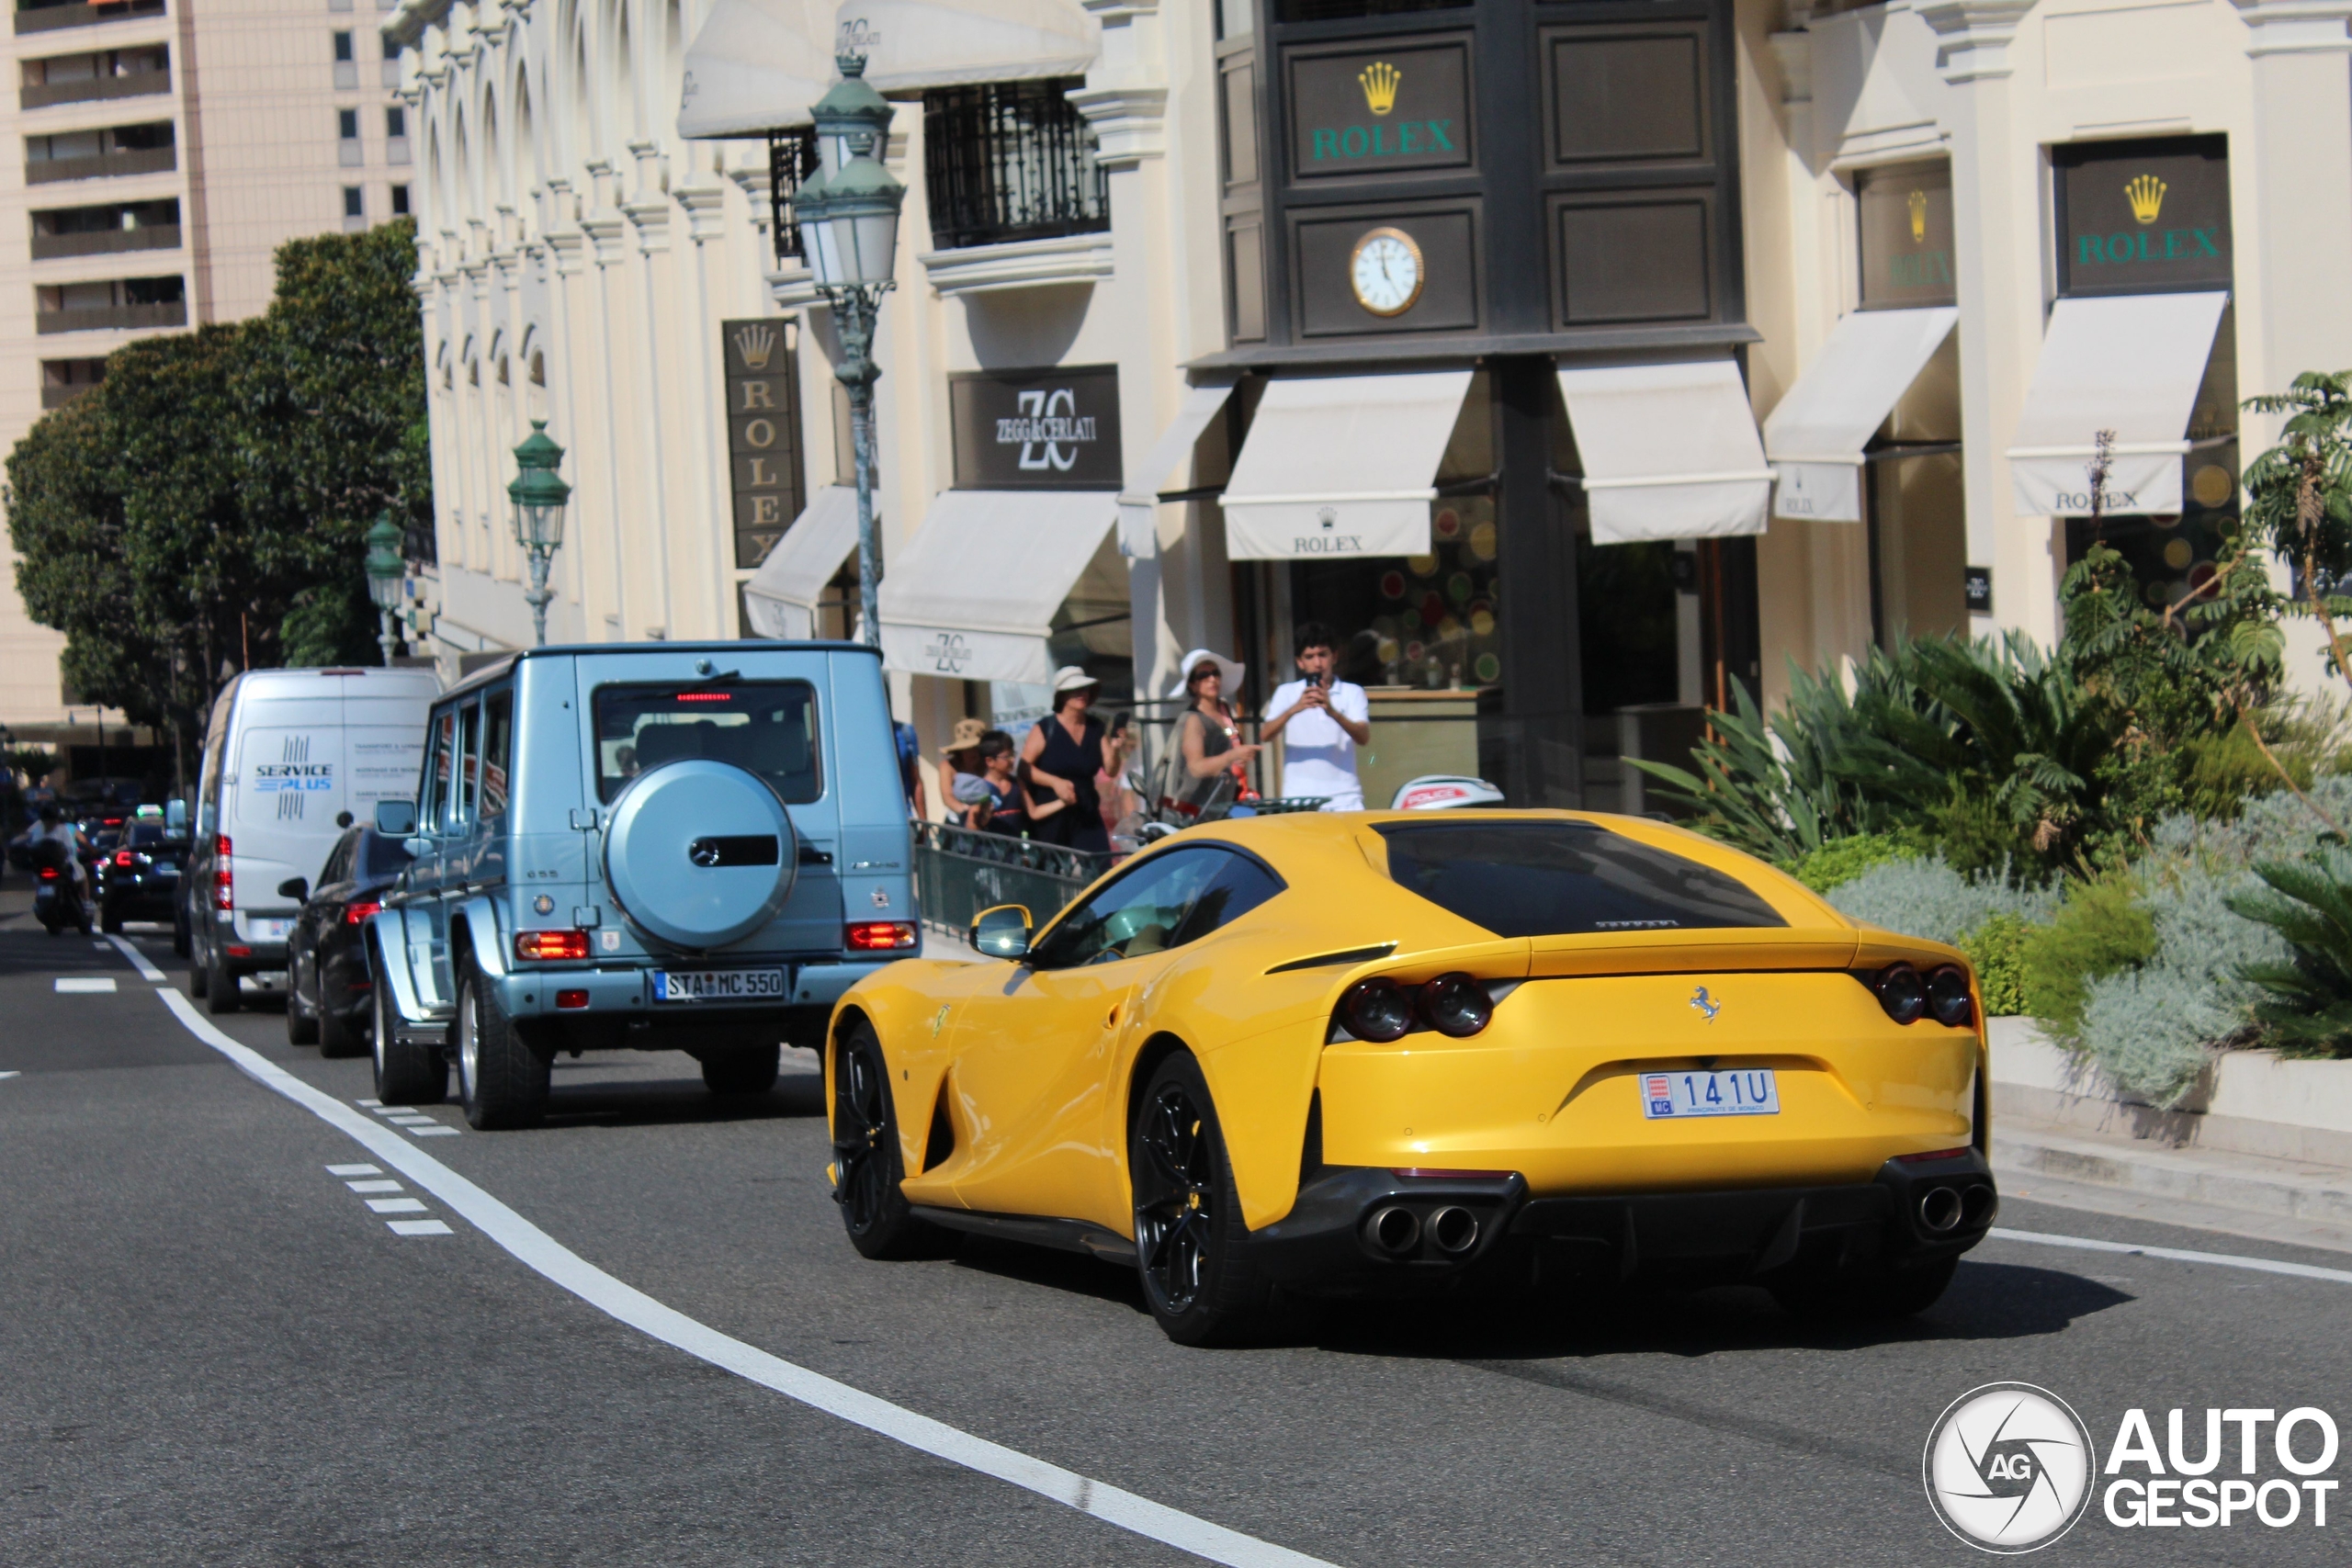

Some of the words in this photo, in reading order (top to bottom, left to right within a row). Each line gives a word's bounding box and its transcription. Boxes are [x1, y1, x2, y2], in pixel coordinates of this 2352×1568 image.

[1312, 118, 1454, 160] ROLEX
[2078, 228, 2219, 264] ROLEX
[1018, 389, 1078, 471] ZC
[741, 380, 780, 563] ROLEX
[2056, 491, 2138, 509] ROEX
[1294, 535, 1363, 552] ROLEX
[255, 764, 333, 777] SERVICE
[279, 778, 332, 791] PLUS
[669, 975, 704, 995] STA
[718, 974, 742, 994] MC
[746, 974, 781, 994] 550
[1684, 1073, 1768, 1106] 141U
[1655, 1101, 1669, 1112] MC
